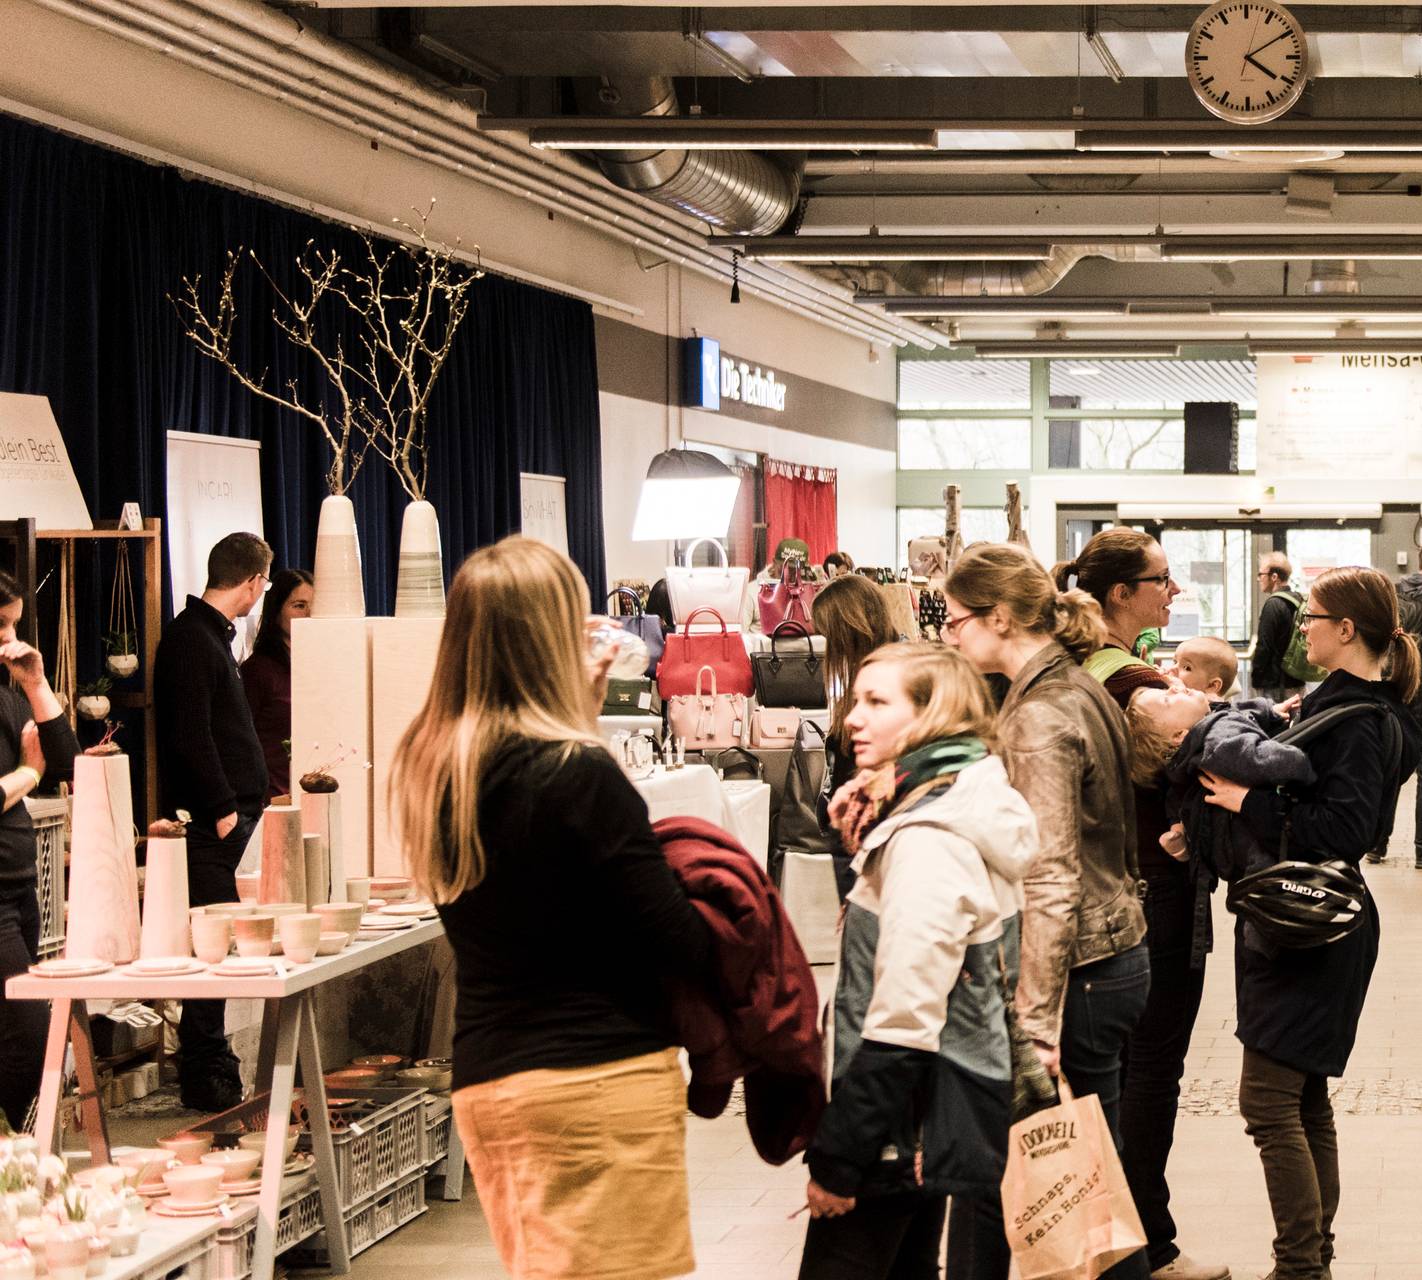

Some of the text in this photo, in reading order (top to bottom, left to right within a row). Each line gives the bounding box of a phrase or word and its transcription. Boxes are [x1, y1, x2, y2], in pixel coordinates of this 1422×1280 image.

[721, 356, 740, 400] Die
[740, 362, 787, 411] Techniker
[28, 437, 61, 463] Best
[1014, 1172, 1078, 1231] Schnaps,
